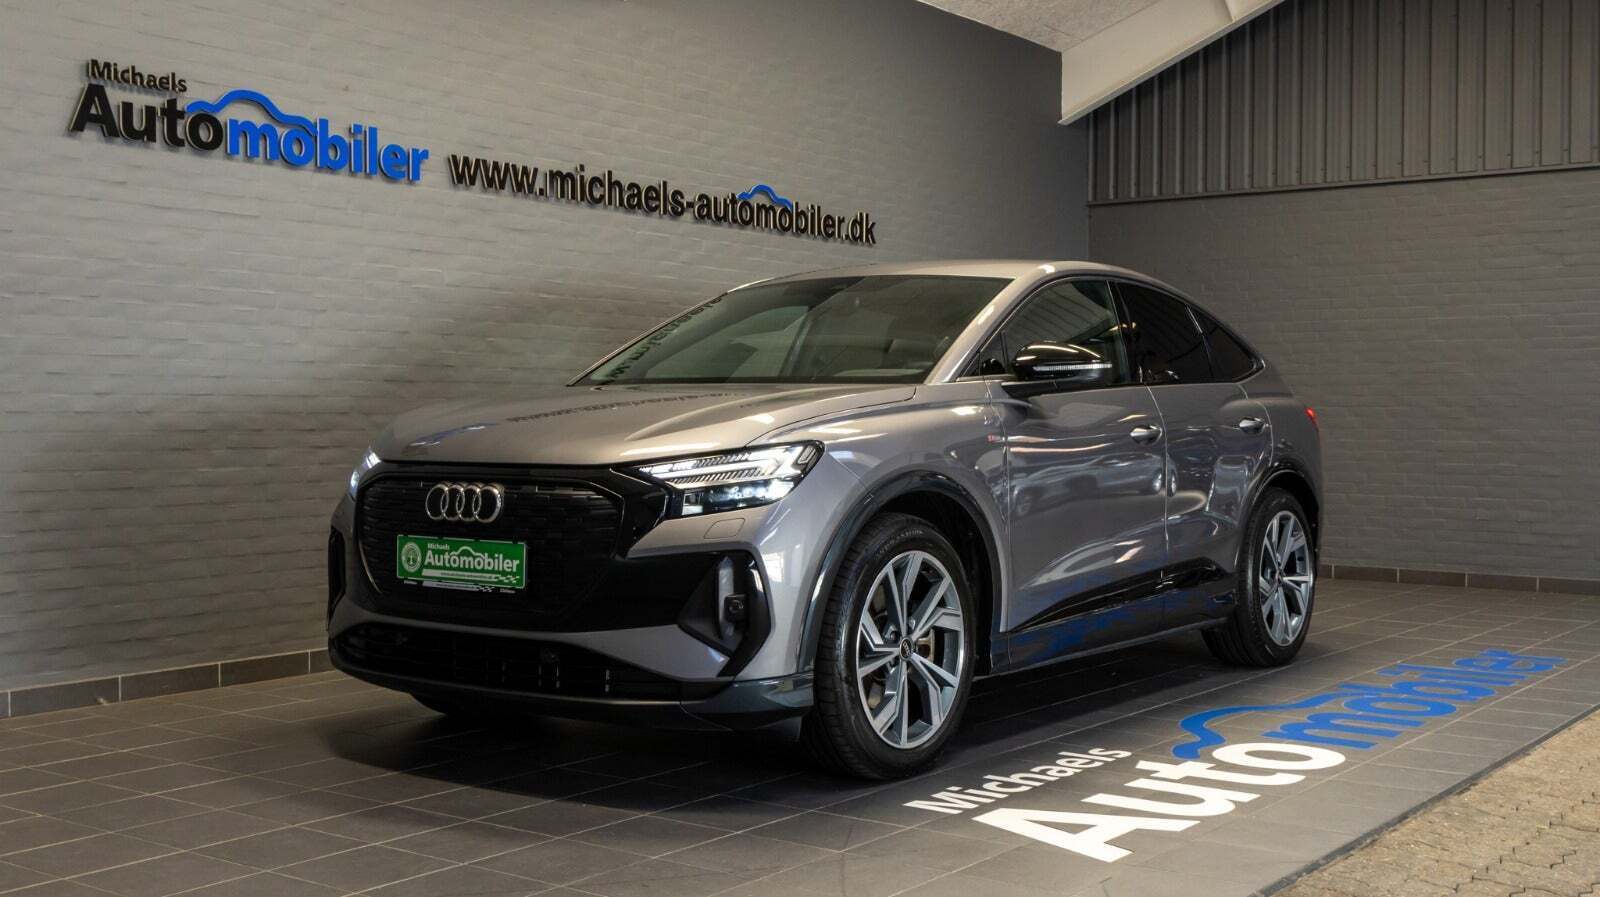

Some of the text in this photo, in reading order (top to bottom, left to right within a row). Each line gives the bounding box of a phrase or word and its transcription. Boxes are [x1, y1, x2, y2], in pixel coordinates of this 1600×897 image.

[89, 59, 187, 92] Michaels
[70, 83, 429, 182] Automobiler
[449, 154, 876, 244] www.michaels-automobiler.dk
[424, 550, 520, 572] Automobiler
[902, 747, 1132, 815] Michaels
[972, 649, 1568, 863] Automobiler
